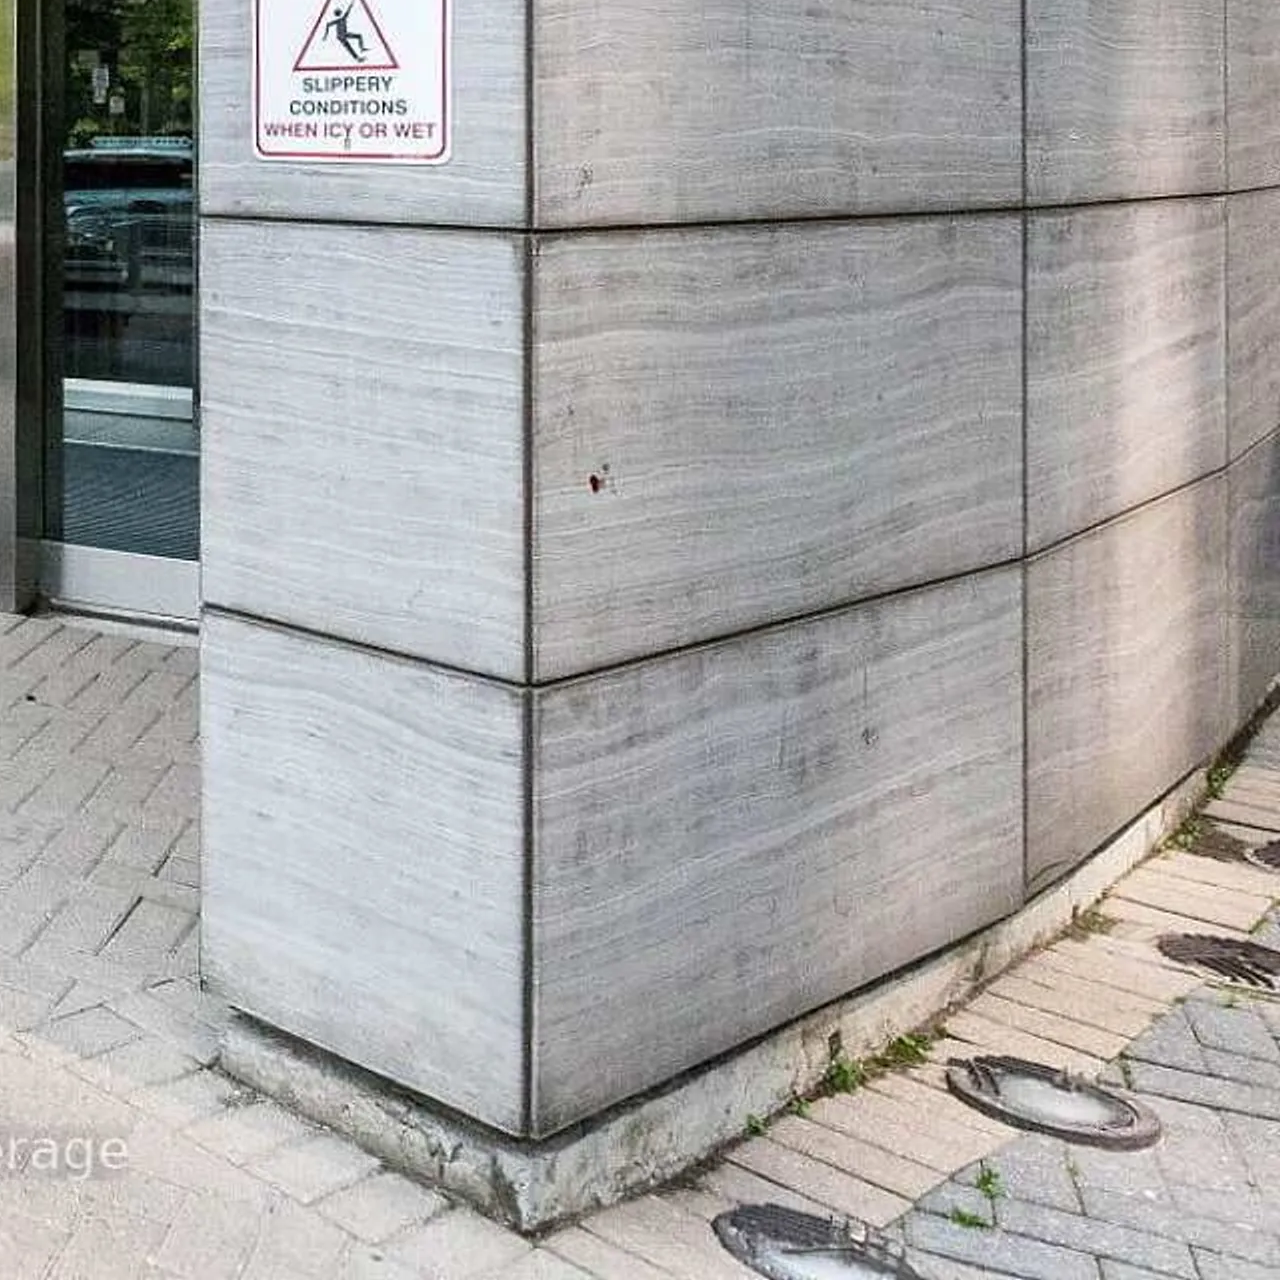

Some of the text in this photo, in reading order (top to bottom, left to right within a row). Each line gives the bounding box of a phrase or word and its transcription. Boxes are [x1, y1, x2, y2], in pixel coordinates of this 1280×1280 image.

[302, 75, 394, 93] SLIPPERY
[289, 99, 408, 116] CONDITIONS
[264, 122, 437, 139] WHEN ICY OR WET
